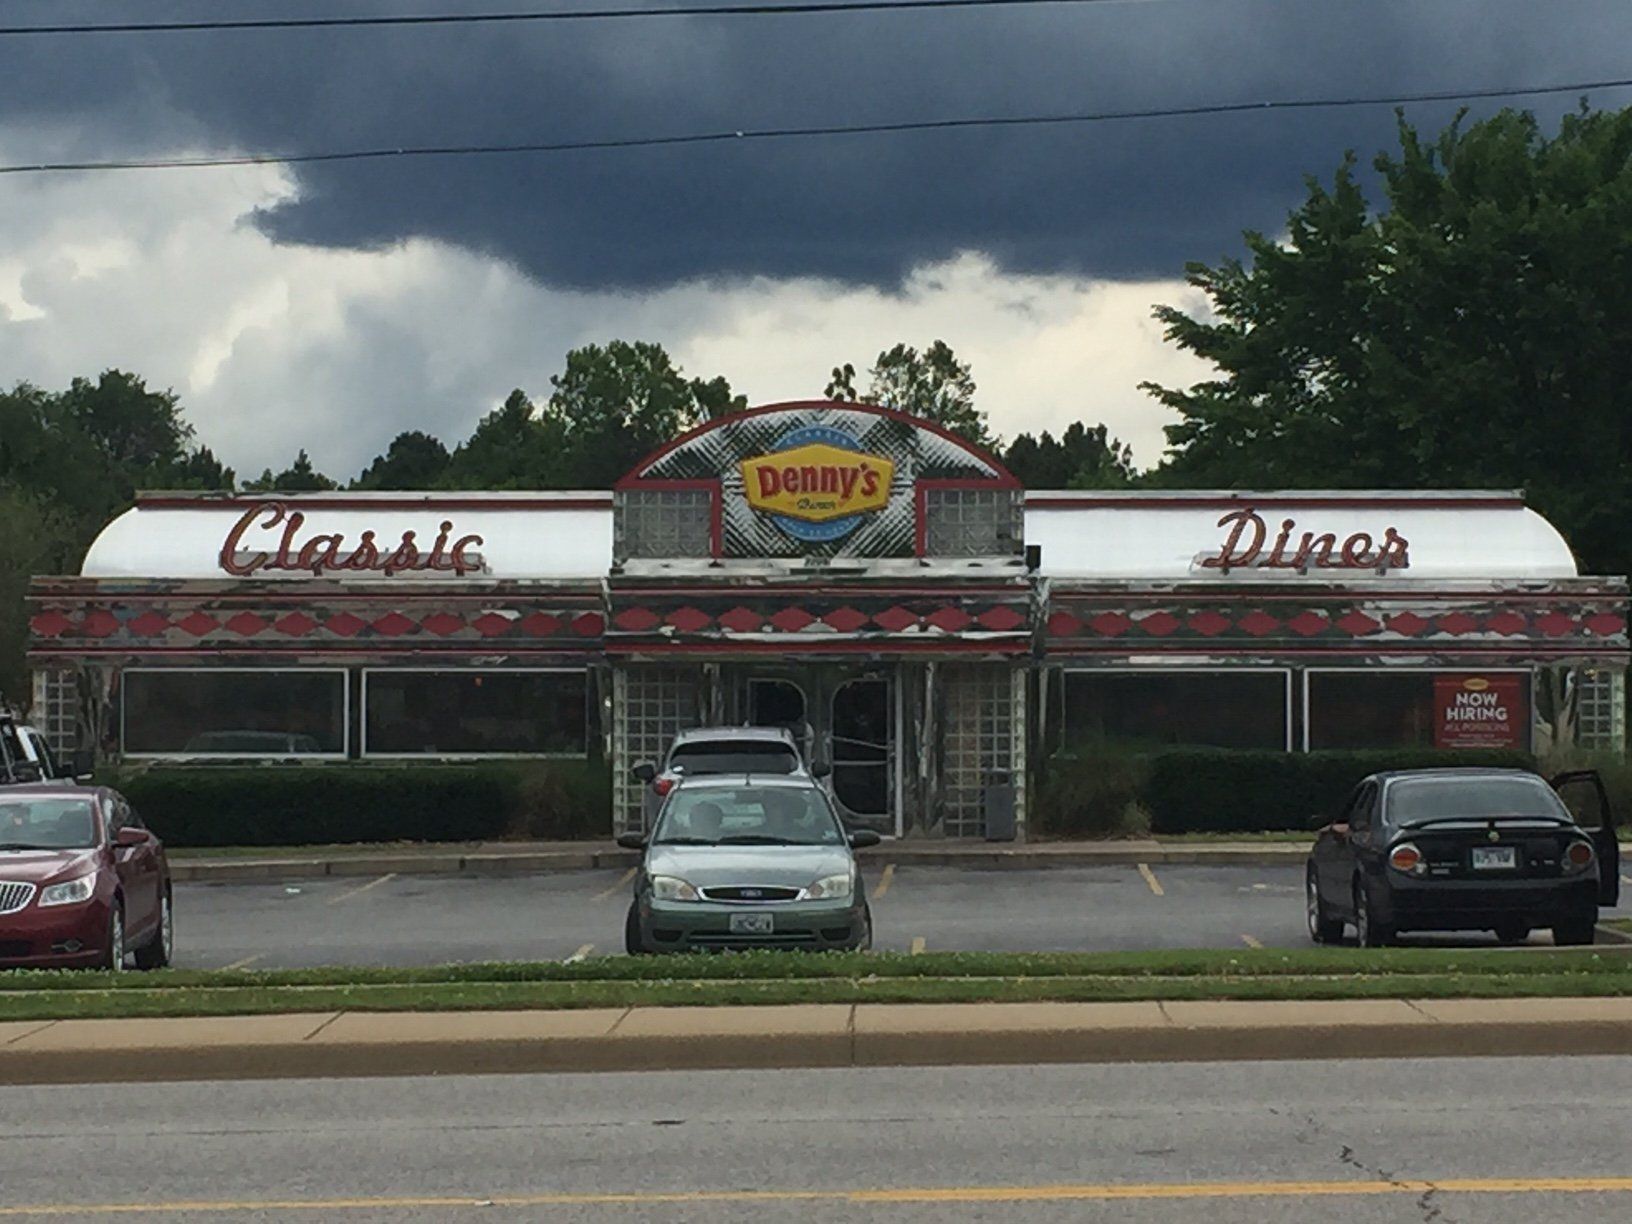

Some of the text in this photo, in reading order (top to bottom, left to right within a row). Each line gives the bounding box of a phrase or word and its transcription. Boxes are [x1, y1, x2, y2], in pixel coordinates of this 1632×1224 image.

[756, 462, 880, 499] Denny's
[220, 502, 484, 576] Classic
[1202, 507, 1410, 569] Diner
[1446, 707, 1508, 721] HIRING
[1455, 692, 1498, 706] NOW
